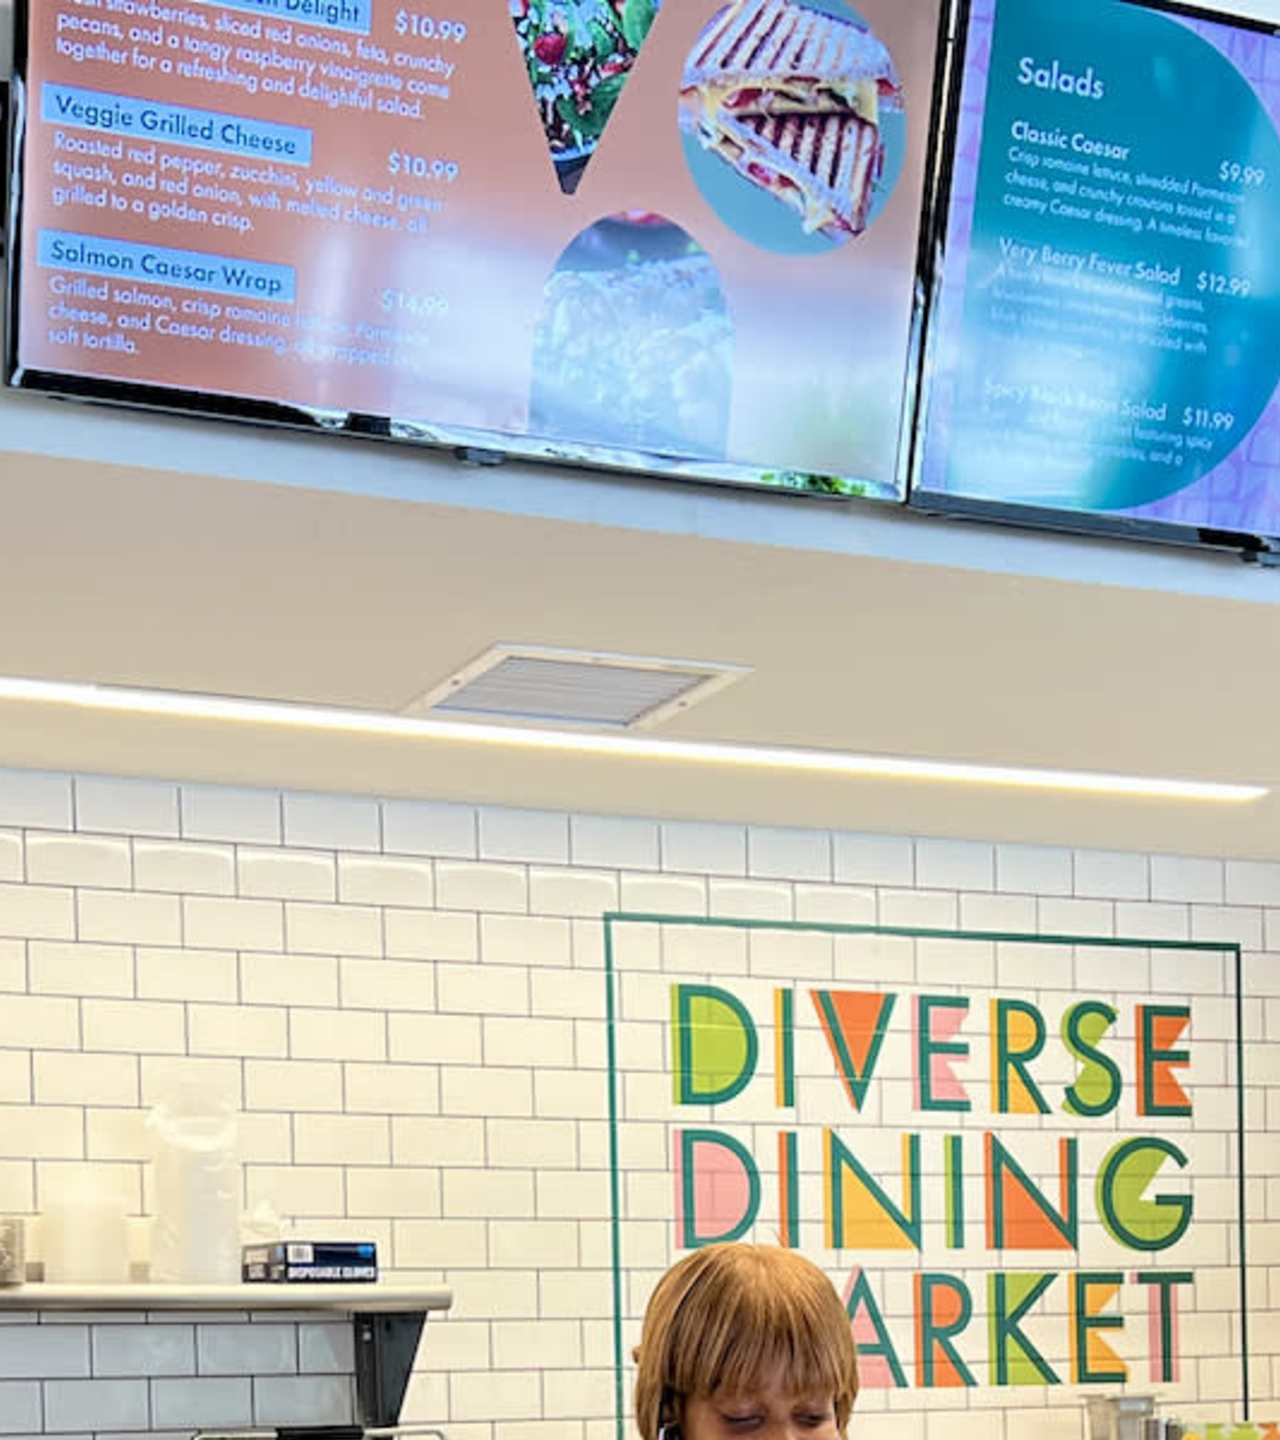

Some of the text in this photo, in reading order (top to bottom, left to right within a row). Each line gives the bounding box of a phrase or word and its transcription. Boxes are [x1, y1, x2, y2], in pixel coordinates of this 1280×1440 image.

[395, 10, 467, 42] $10.99
[55, 36, 426, 119] together for a refreshing and delightful salad.
[57, 12, 449, 99] pecans, and a tangy raspberry vinaigrette come
[1017, 56, 1105, 100] Salads
[56, 94, 297, 156] Veggie Grilled Cheese
[1011, 120, 1130, 161] Classic Caesar
[54, 130, 300, 190] Roasted red pepper, zucchini,
[387, 151, 459, 182] $10.99
[1220, 160, 1265, 186] $9.99
[53, 187, 255, 234] grilled to a golden crisp.
[51, 240, 282, 296] Salmon Caesar Wrap
[1000, 237, 1181, 286] Very Berry Fever Salad
[1197, 271, 1251, 297] $12.99
[48, 330, 140, 356] soft tortilla.
[1121, 399, 1167, 422] Salad
[1183, 407, 1234, 430] $11.99
[670, 982, 1193, 1118] DIVERSE
[673, 1126, 1194, 1252] DINING
[842, 1264, 1195, 1389] ARKET
